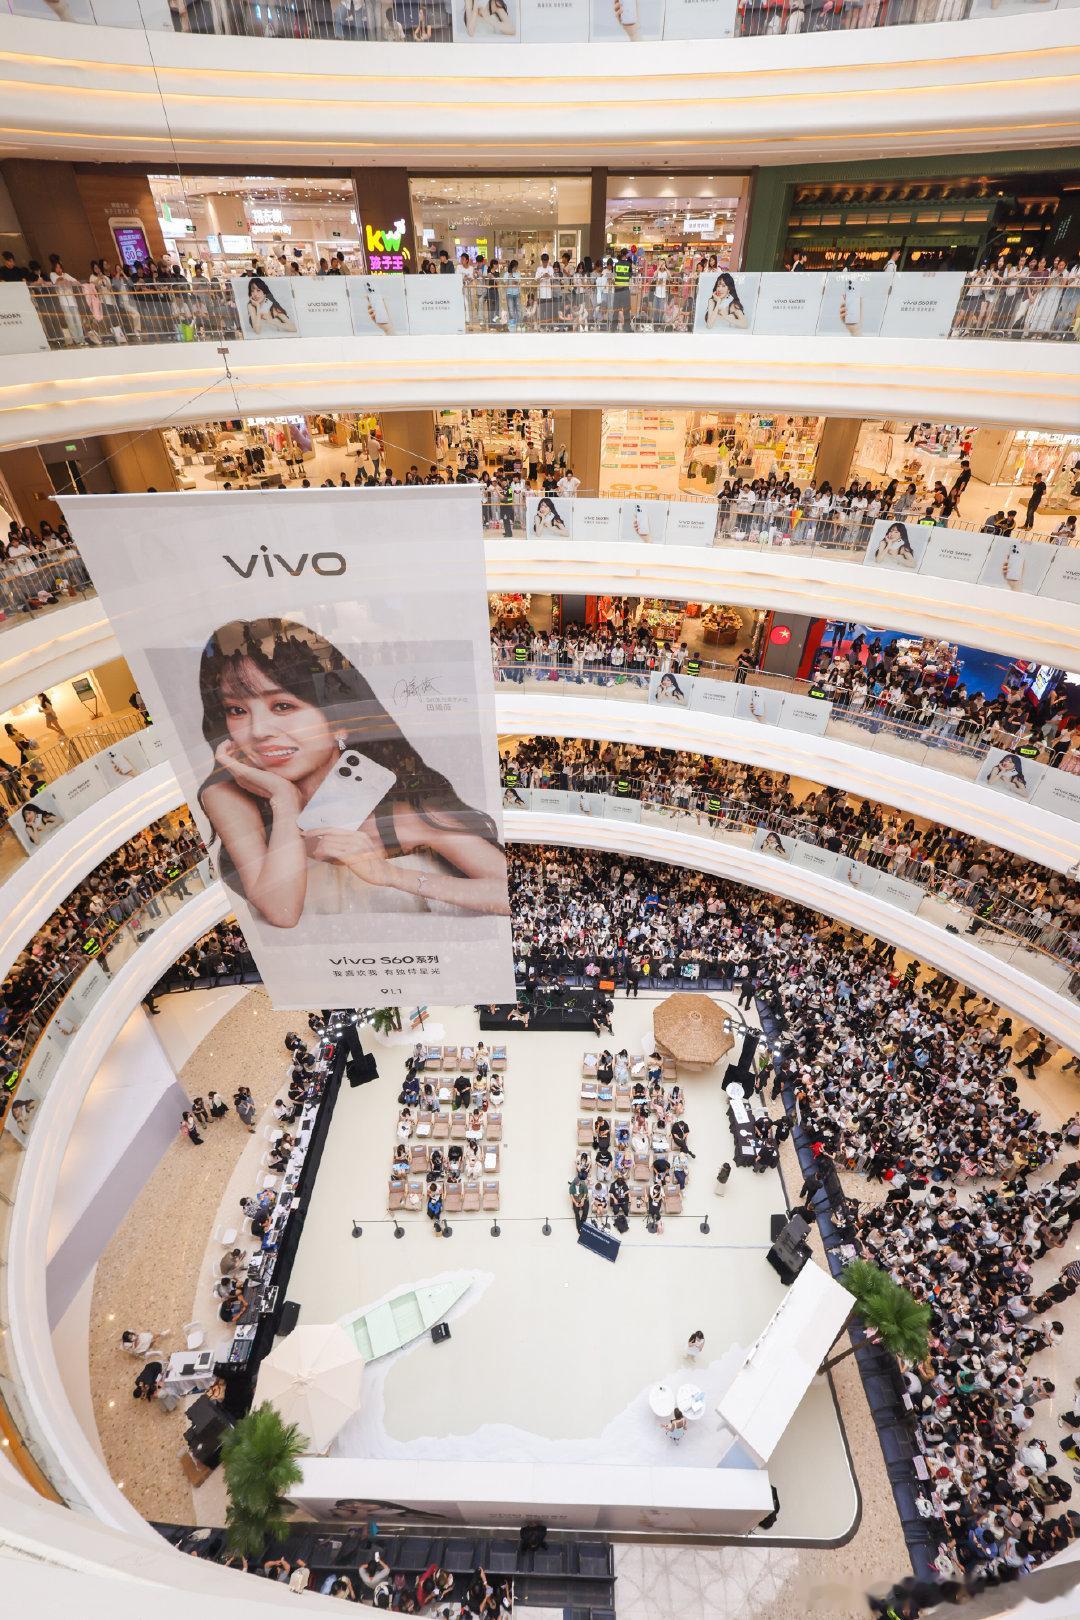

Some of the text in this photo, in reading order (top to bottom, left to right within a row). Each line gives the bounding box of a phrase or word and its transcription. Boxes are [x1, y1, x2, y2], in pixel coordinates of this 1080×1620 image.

[369, 255, 404, 270] 孩子王
[222, 545, 347, 578] vivo
[329, 955, 439, 965] vivo S60系列
